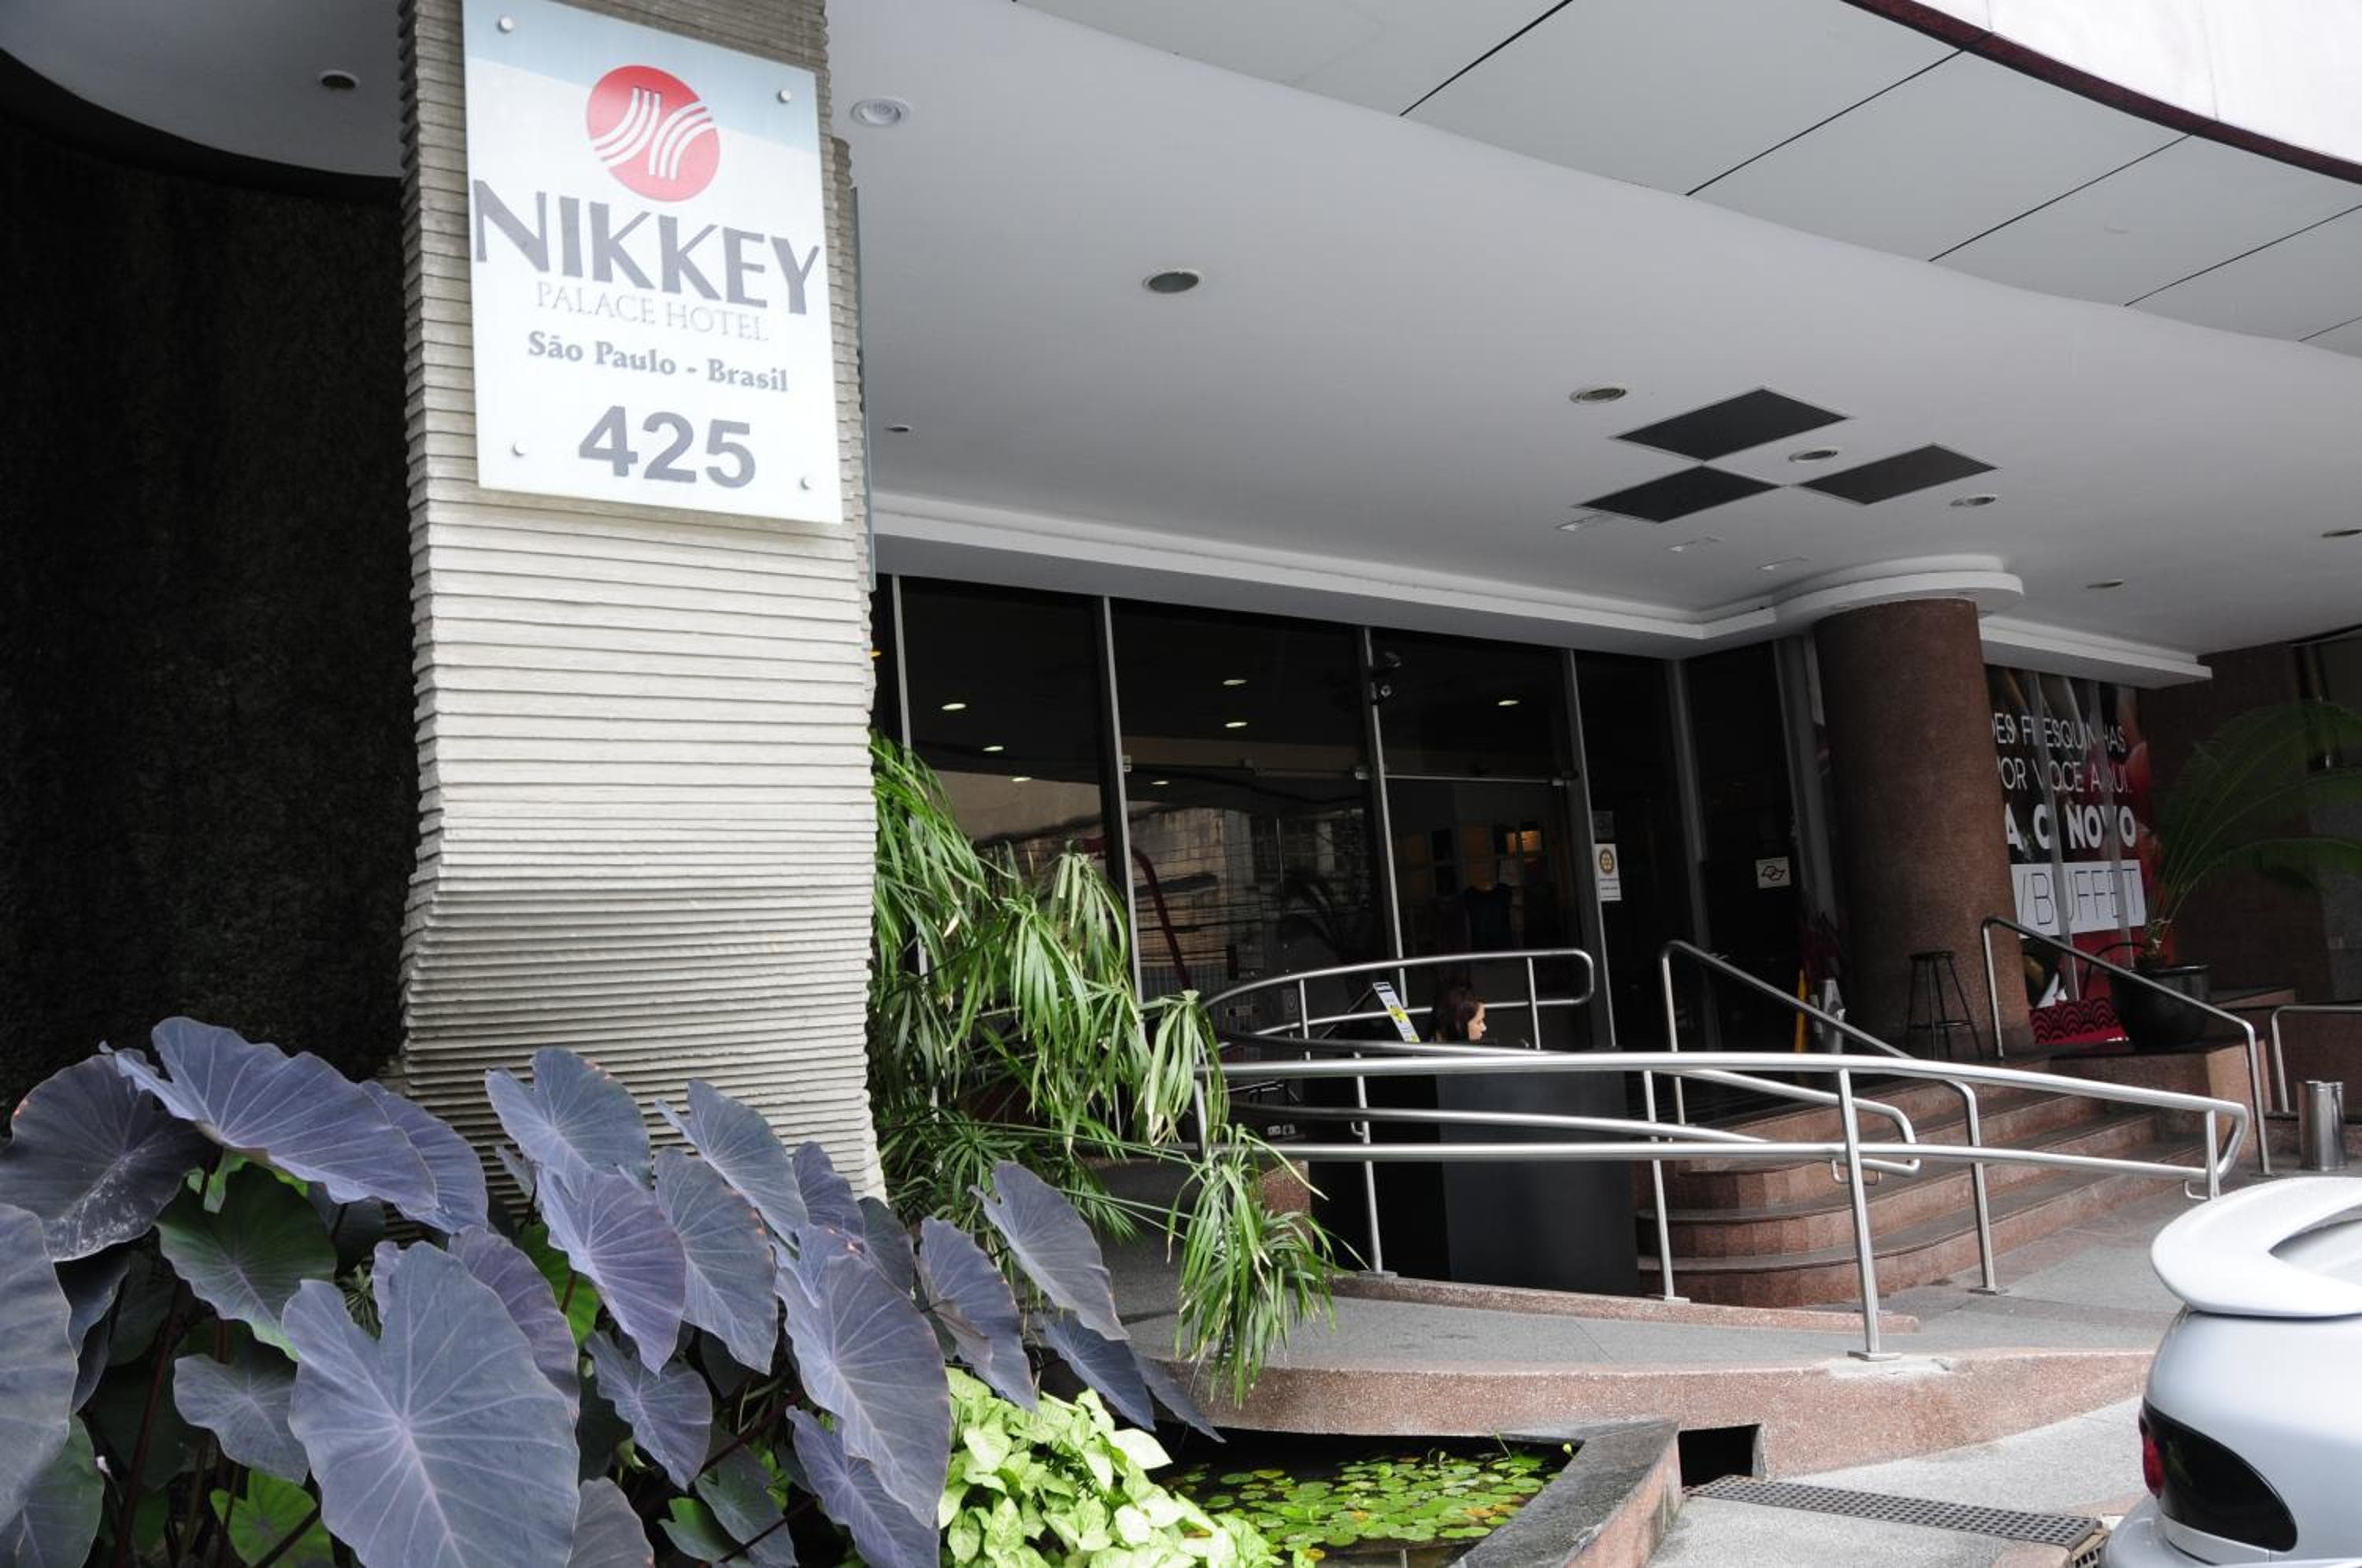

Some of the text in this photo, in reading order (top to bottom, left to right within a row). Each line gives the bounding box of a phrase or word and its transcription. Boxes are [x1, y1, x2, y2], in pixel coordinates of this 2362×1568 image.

[473, 179, 820, 315] NIKKEY
[536, 281, 769, 342] PALACE HOTEL
[528, 330, 583, 363] São
[595, 340, 676, 376] Paulo
[707, 358, 788, 393] Brasil
[579, 405, 757, 490] 425
[1991, 712, 2016, 744] ES
[2065, 804, 2137, 850] NOVO
